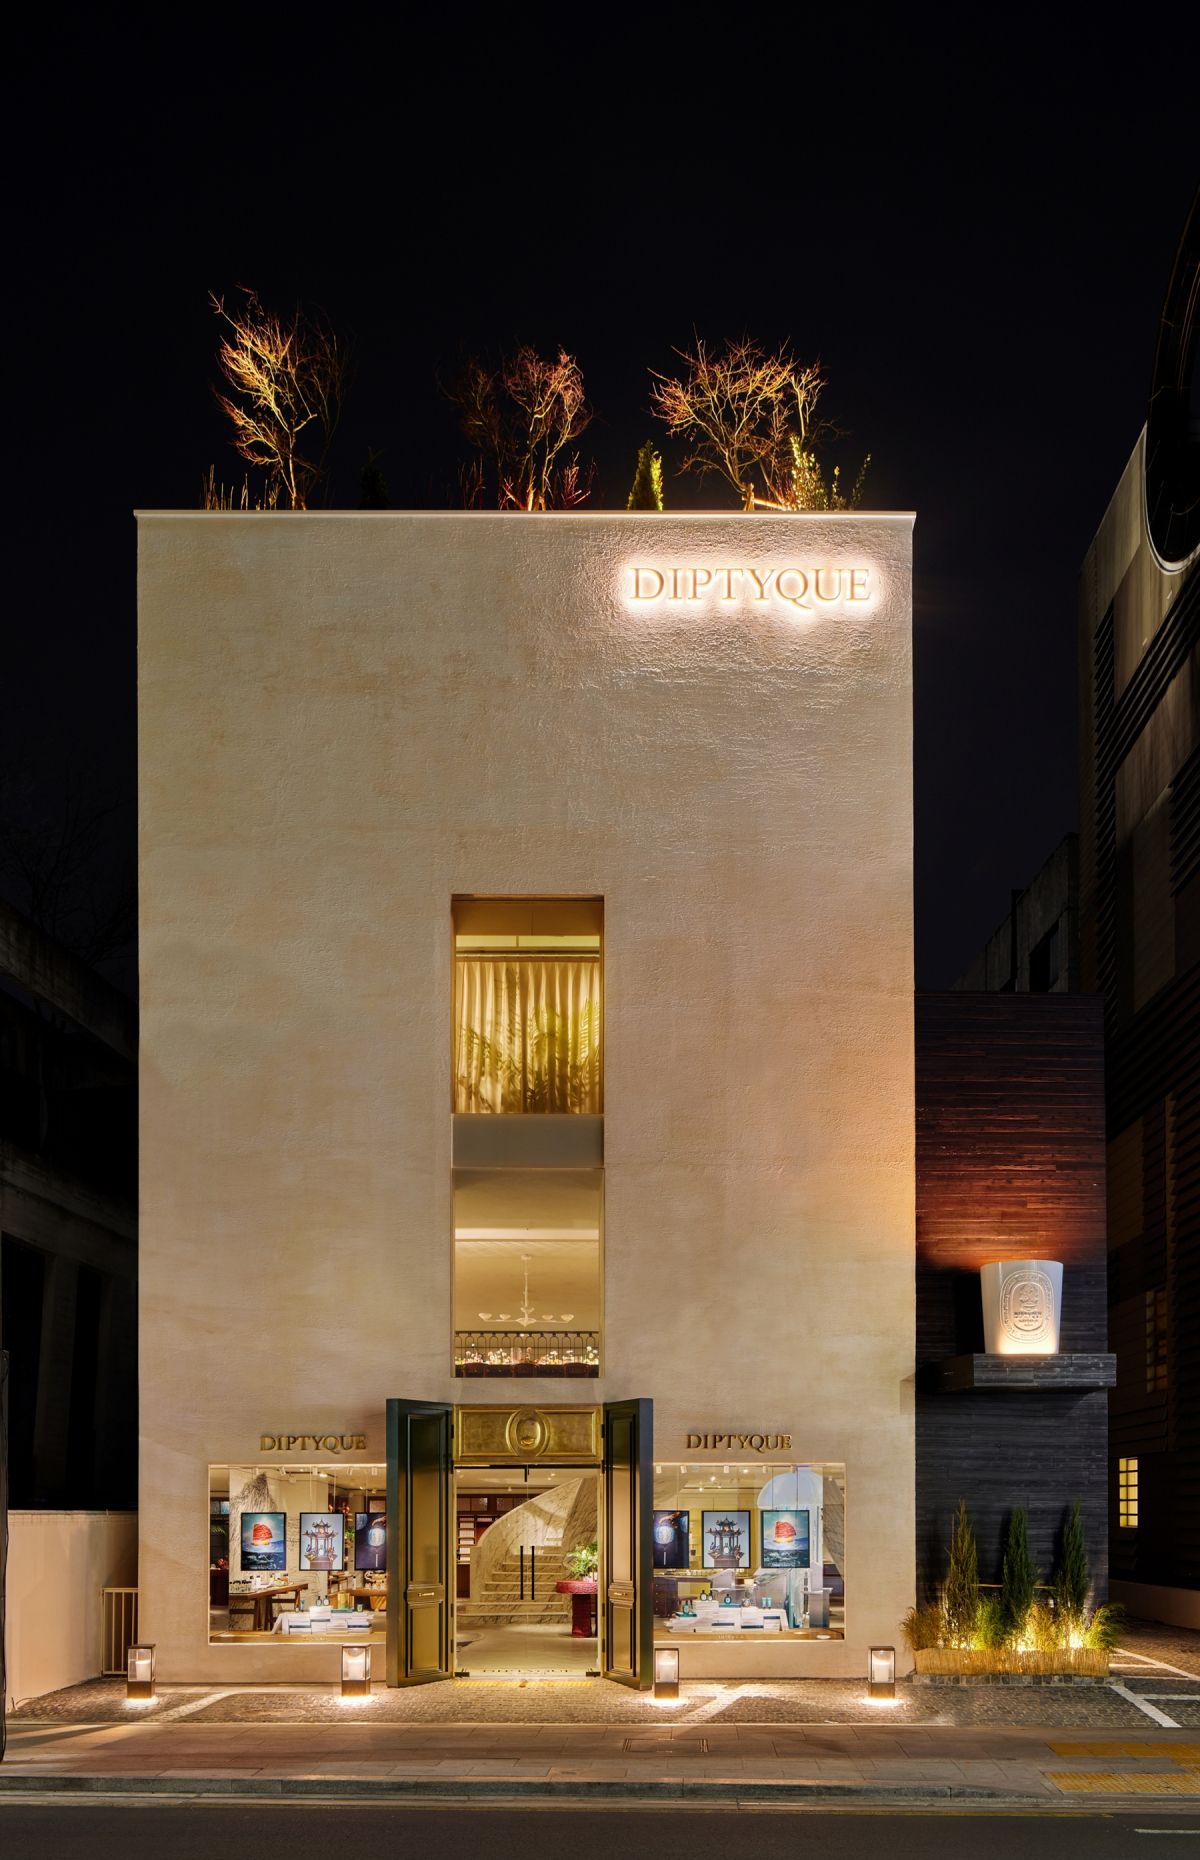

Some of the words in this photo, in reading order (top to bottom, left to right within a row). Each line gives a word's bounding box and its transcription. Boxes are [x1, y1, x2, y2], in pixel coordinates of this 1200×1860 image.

[629, 567, 872, 610] DIPTYQUE
[260, 1435, 367, 1455] DIPTYQUE
[686, 1434, 793, 1454] DIPTYQUE
